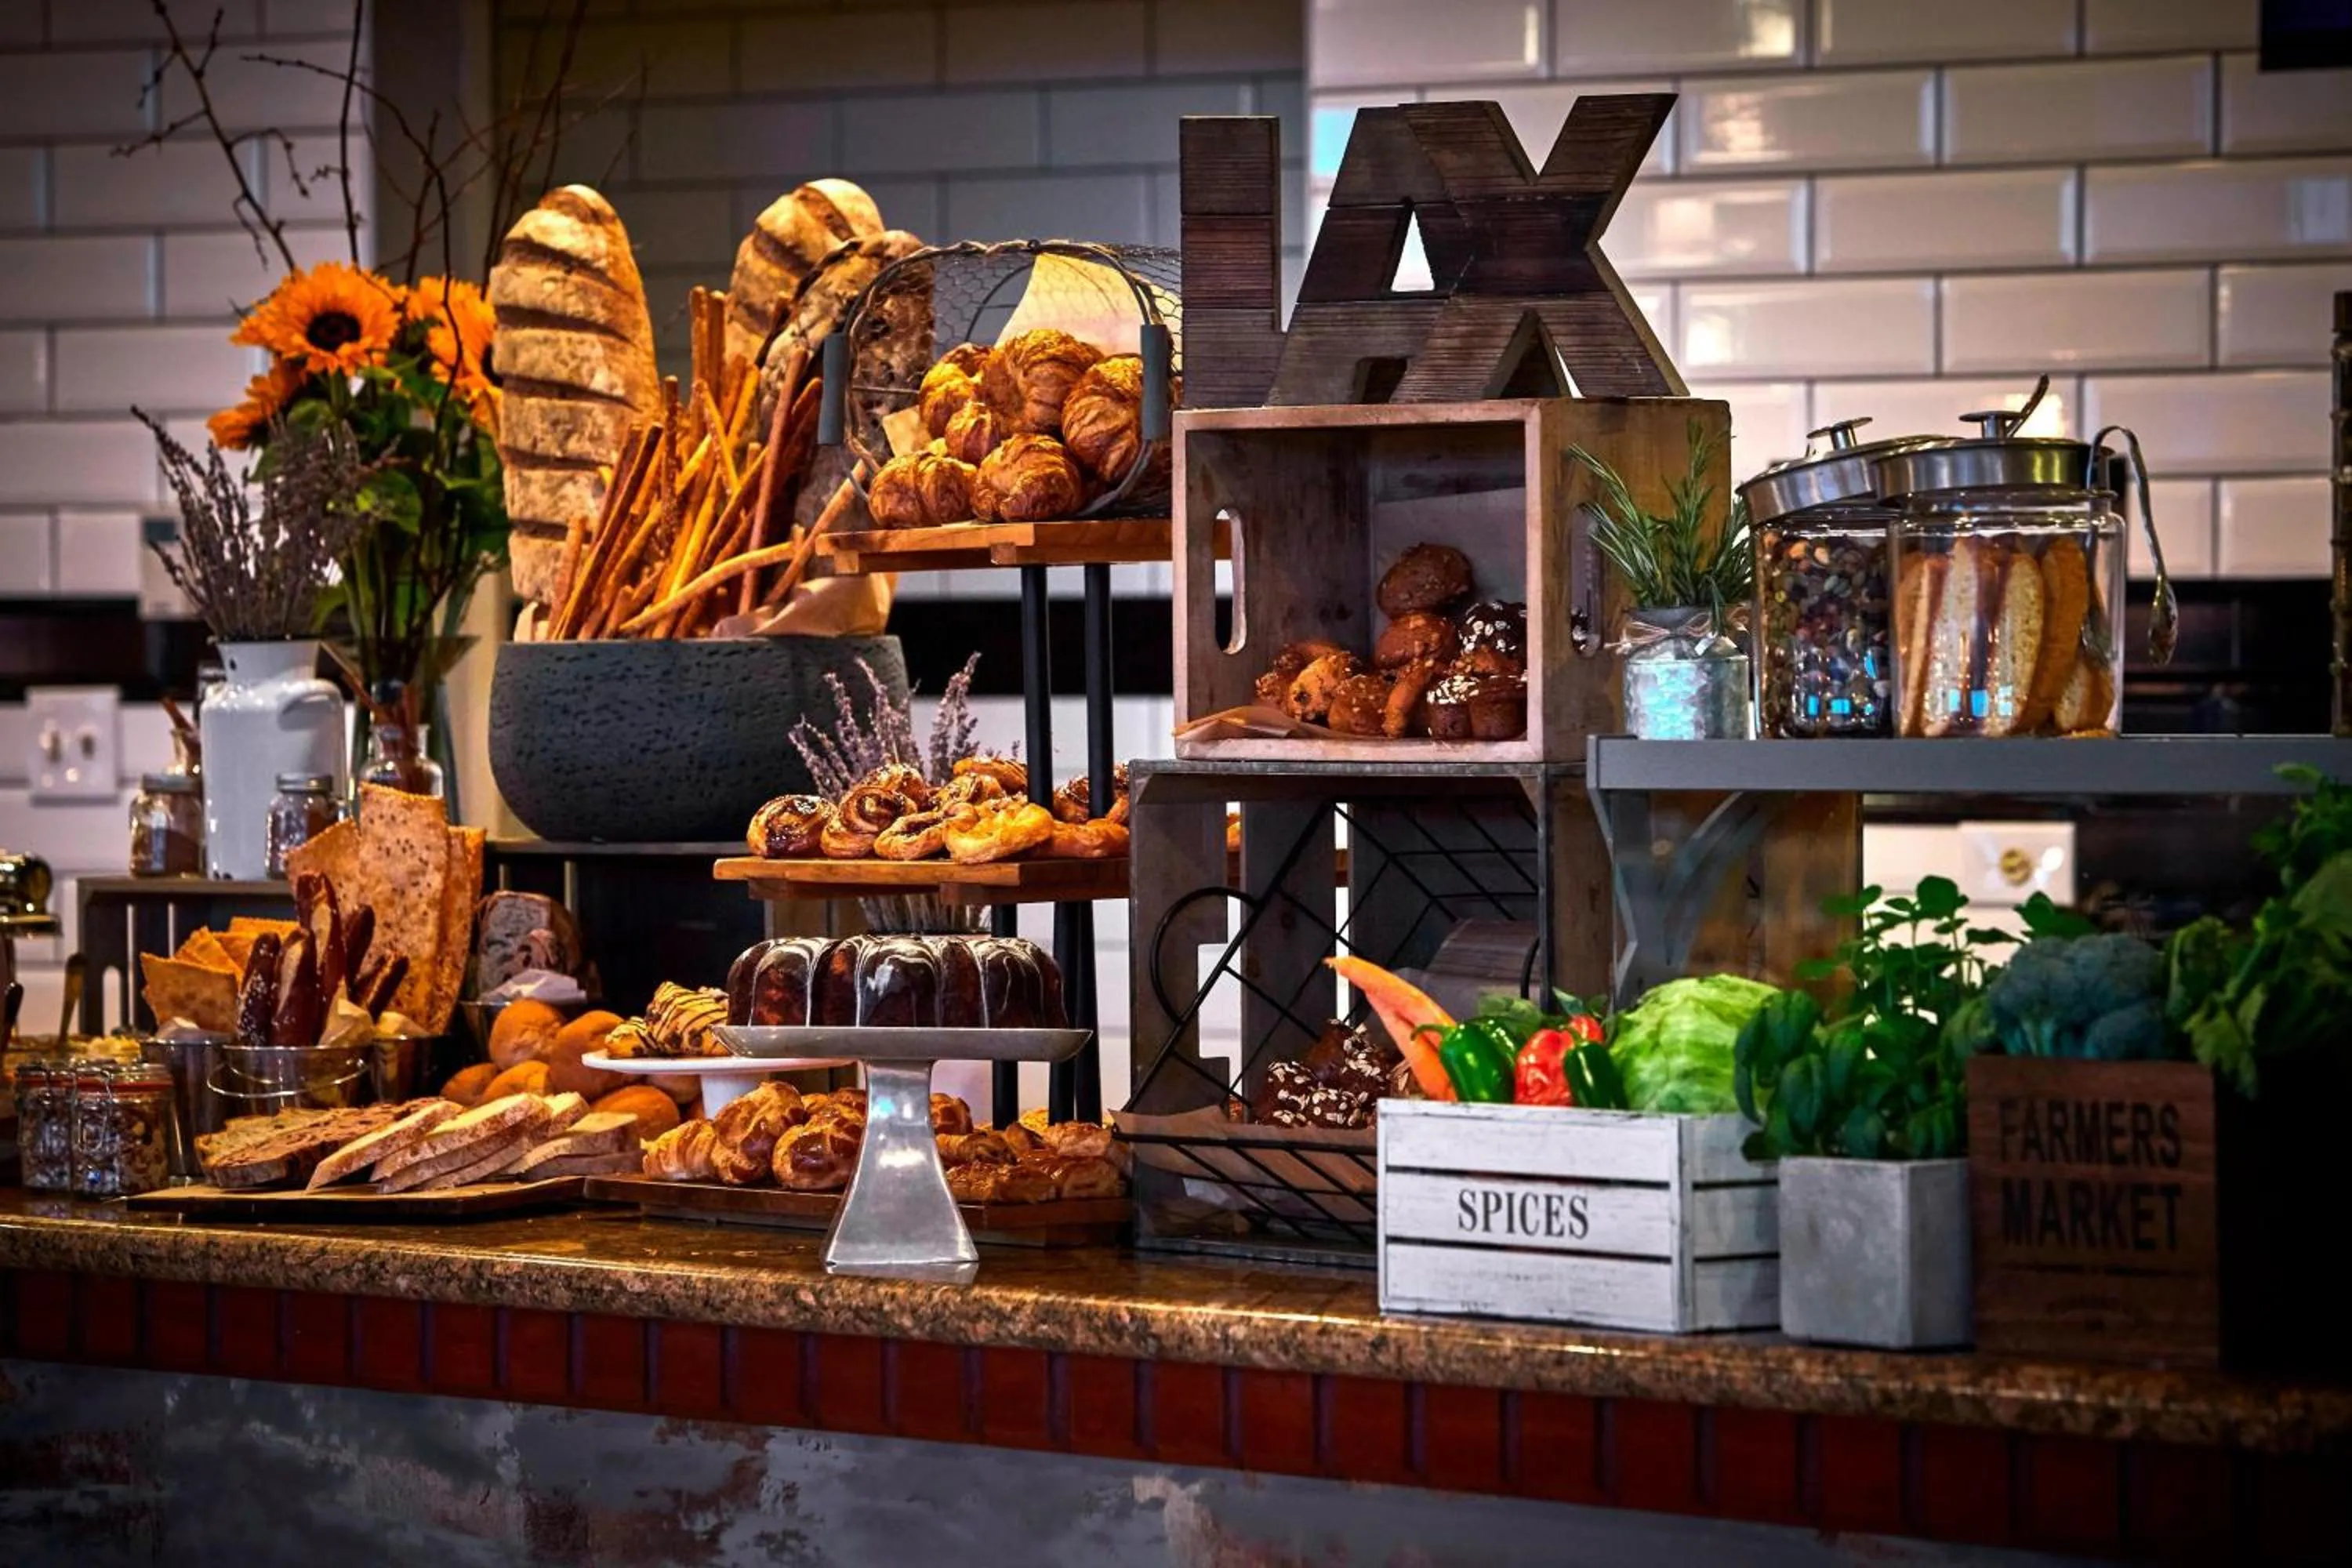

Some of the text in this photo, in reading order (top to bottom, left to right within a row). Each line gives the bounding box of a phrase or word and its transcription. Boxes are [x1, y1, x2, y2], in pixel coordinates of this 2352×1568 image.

[1180, 93, 1691, 408] LAX
[1998, 1098, 2183, 1168] FARMERS
[1457, 1188, 1590, 1240] SPICES
[2000, 1177, 2183, 1252] MARKET
